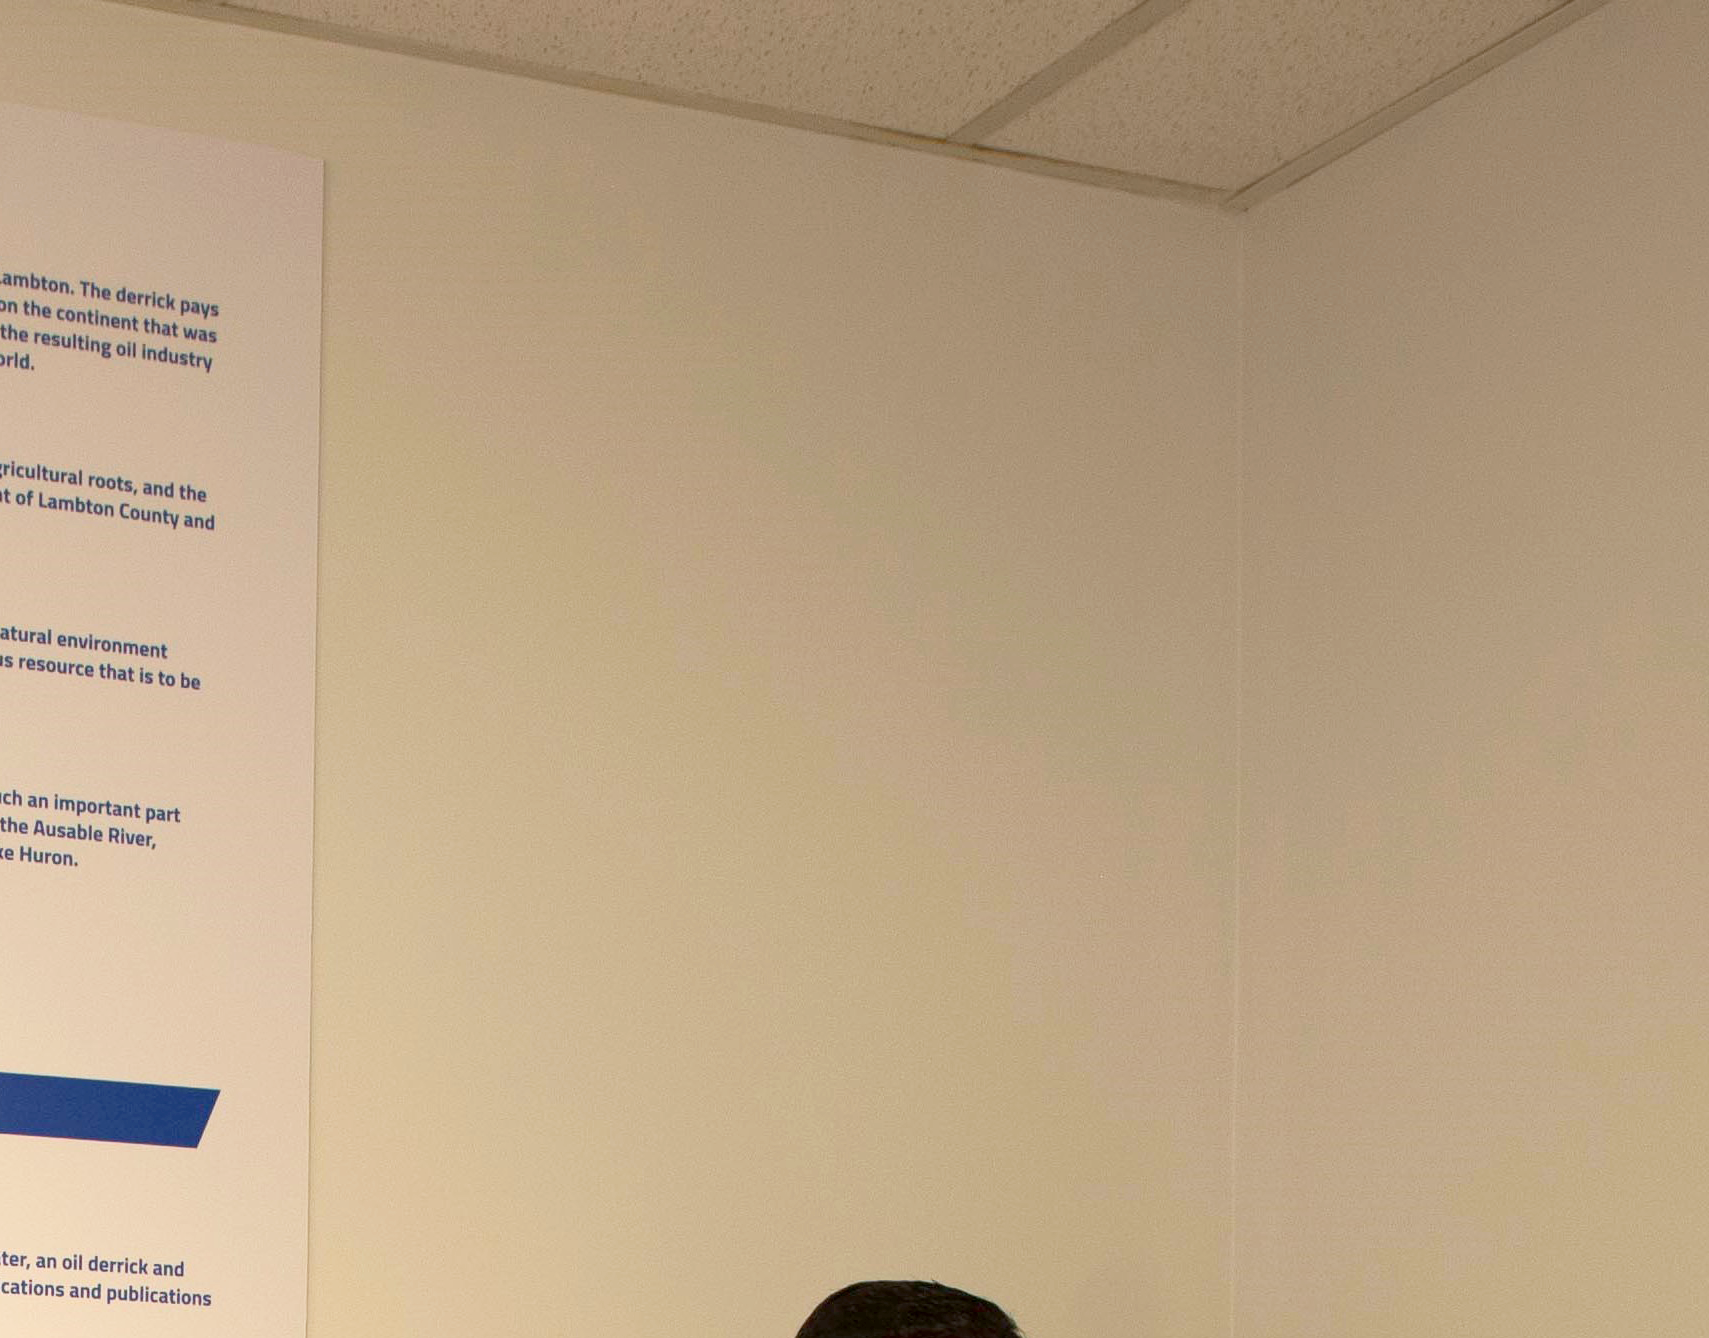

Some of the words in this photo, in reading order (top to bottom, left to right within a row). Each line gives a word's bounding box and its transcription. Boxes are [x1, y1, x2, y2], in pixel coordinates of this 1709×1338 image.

[80, 280, 111, 301] The
[116, 287, 176, 311] derrick
[181, 299, 220, 320] pays
[23, 300, 52, 319] the
[57, 308, 139, 333] continent
[144, 317, 179, 338] that
[184, 327, 218, 344] was
[0, 323, 29, 343] the
[34, 332, 112, 359] resulting
[117, 341, 137, 359] oil
[142, 343, 213, 374] industry
[57, 633, 168, 660] environment
[19, 657, 95, 678] resource
[100, 663, 135, 683] that
[140, 667, 154, 685] is
[159, 671, 176, 687] to
[181, 672, 201, 691] be
[36, 1255, 57, 1269] an
[63, 1254, 83, 1271] oil
[89, 1255, 149, 1275] derrick
[153, 1261, 185, 1277] and
